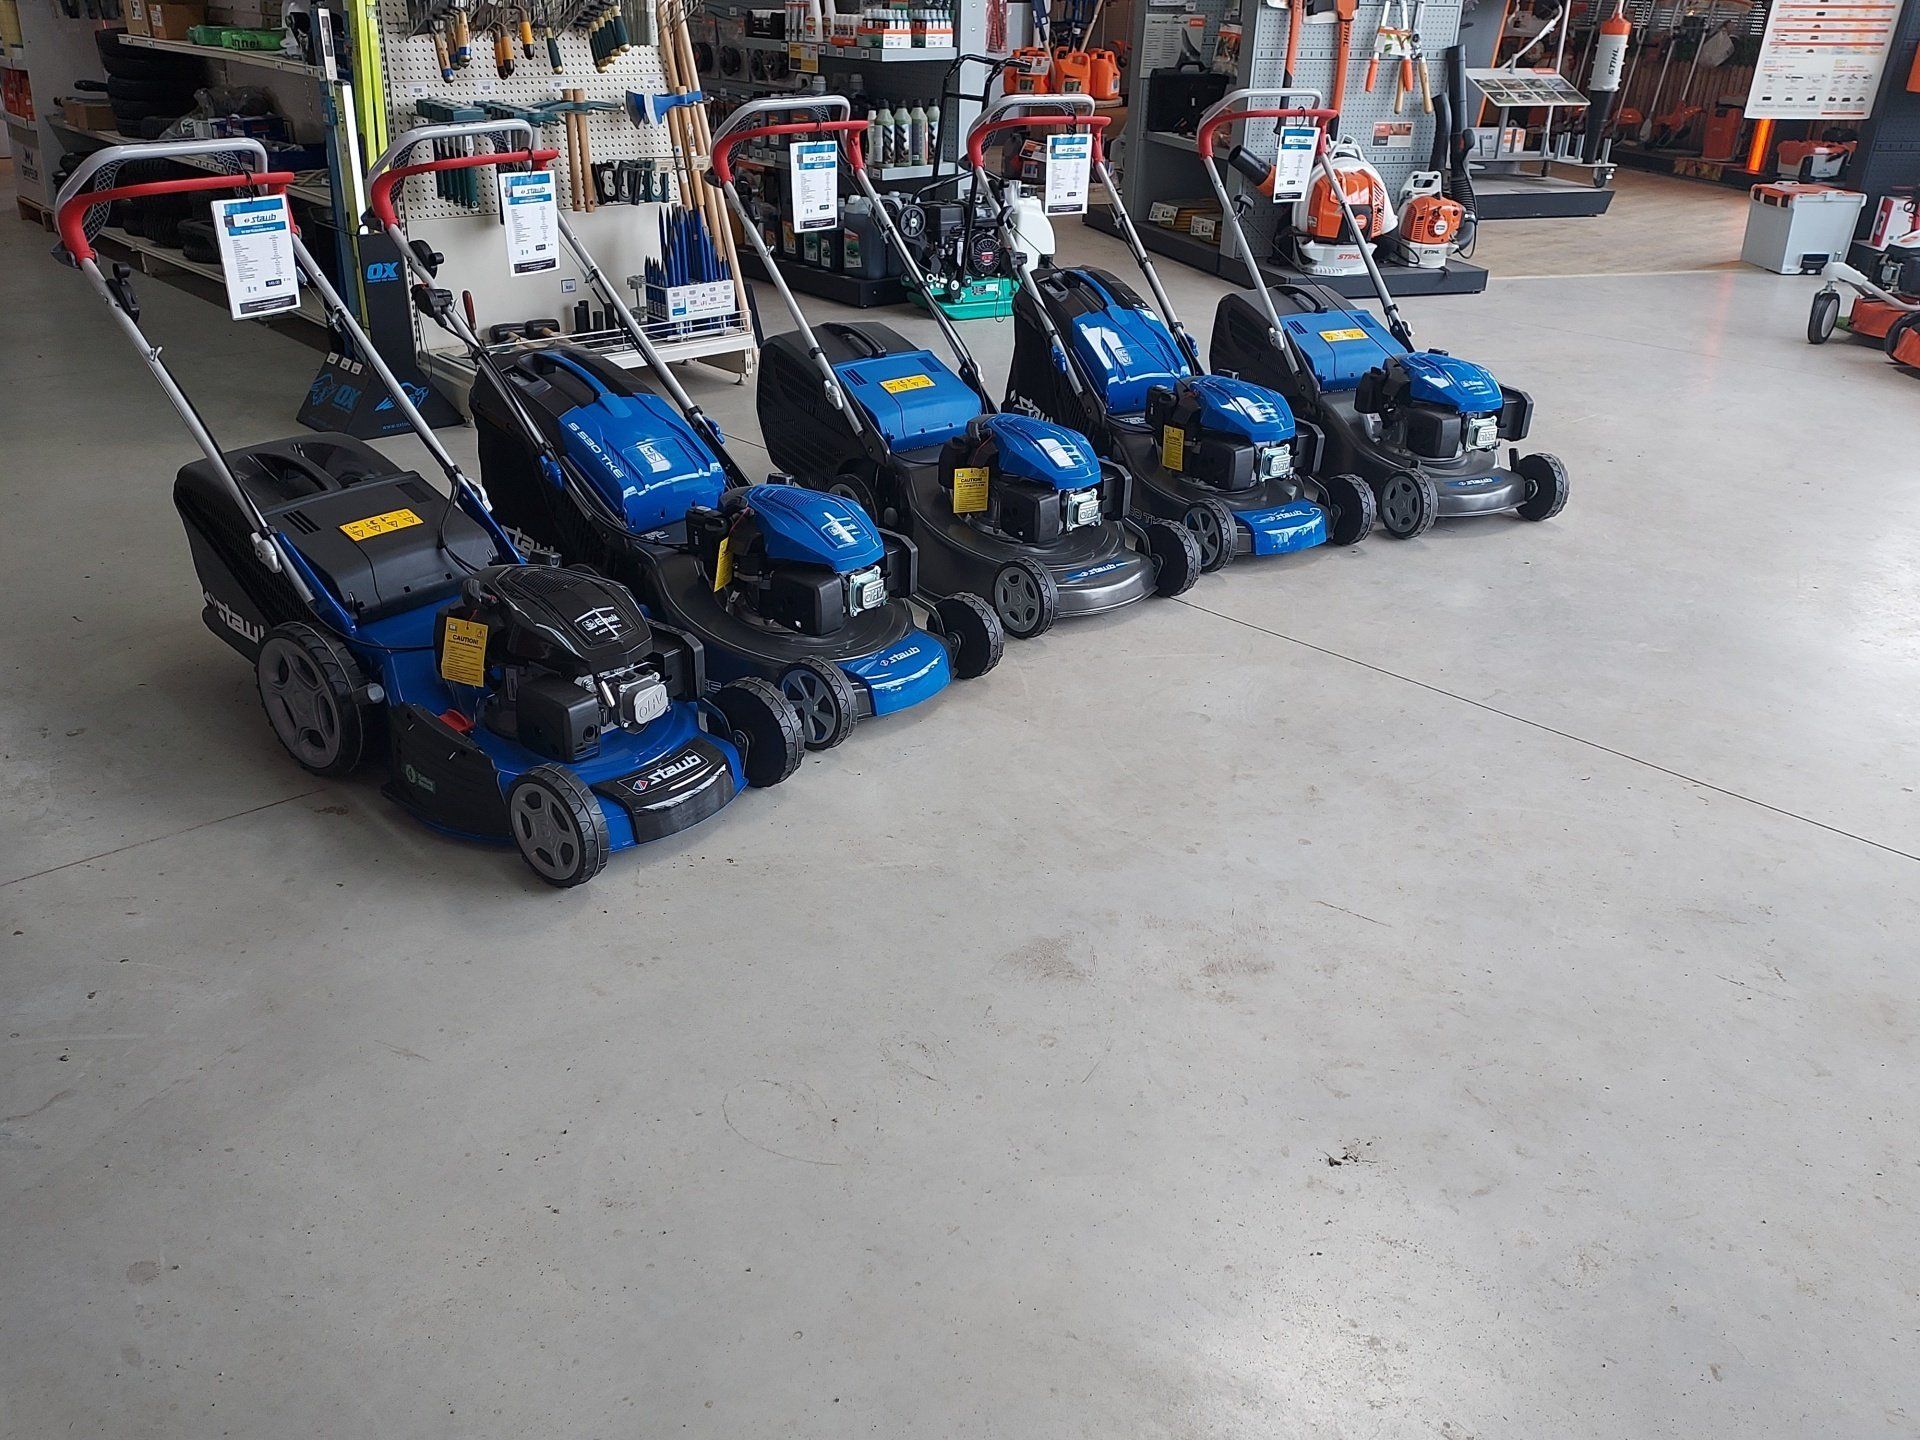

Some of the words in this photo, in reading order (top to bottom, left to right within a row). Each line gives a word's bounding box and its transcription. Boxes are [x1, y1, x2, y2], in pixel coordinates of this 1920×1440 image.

[1608, 46, 1620, 75] STIHL
[251, 214, 277, 224] staub
[367, 262, 399, 279] OX
[568, 422, 580, 432] S
[577, 431, 602, 454] 530
[601, 453, 625, 479] TKE
[1088, 563, 1116, 576] staub
[452, 633, 480, 646] CAUTION!
[889, 646, 921, 664] staub
[647, 754, 702, 786] staub
